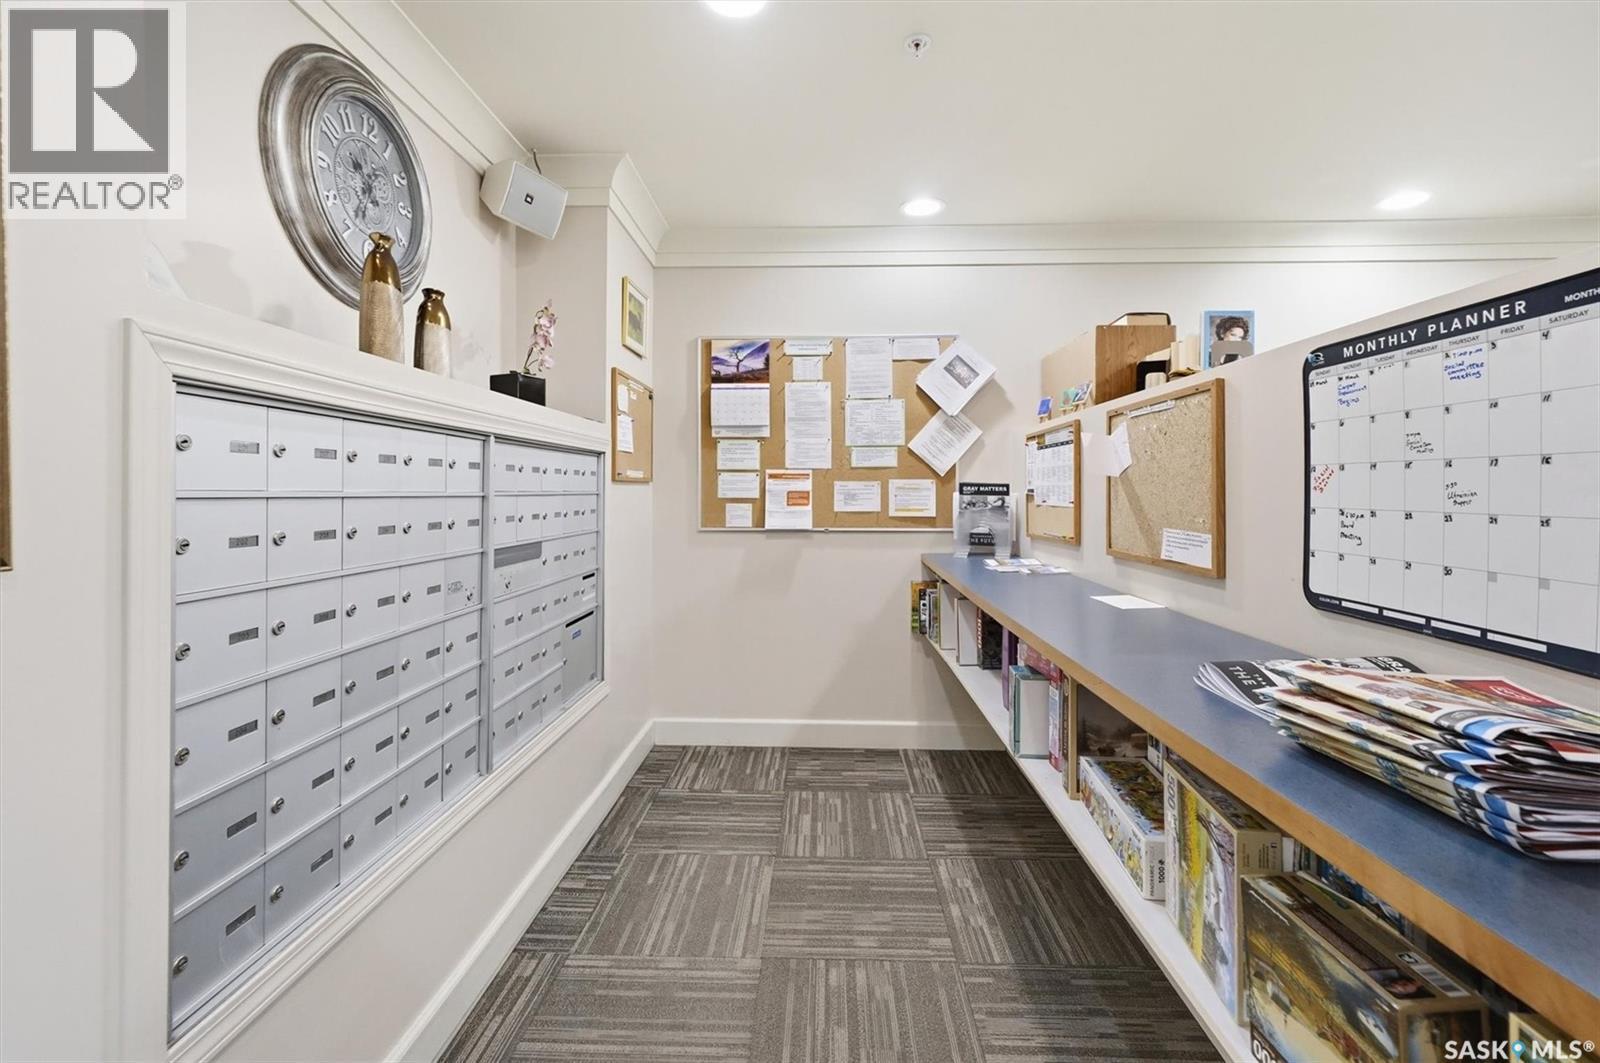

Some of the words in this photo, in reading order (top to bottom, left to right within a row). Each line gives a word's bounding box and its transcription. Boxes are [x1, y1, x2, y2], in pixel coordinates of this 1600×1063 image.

[337, 103, 356, 133] 11
[320, 112, 342, 148] 10
[360, 112, 378, 144] 12
[316, 151, 332, 172] 9
[393, 172, 408, 188] 2
[398, 202, 412, 219] 3
[1549, 310, 1589, 324] SATURDAY
[1342, 328, 1417, 358] MONTHLY
[1428, 300, 1526, 337] PLANNER
[1500, 325, 1525, 334] FRIDAY
[1542, 330, 1550, 340] 4
[1406, 345, 1438, 356] WEDNESDAY
[1449, 336, 1480, 346] THURSDAY
[1228, 665, 1258, 686] THE
[1167, 773, 1176, 810] 500
